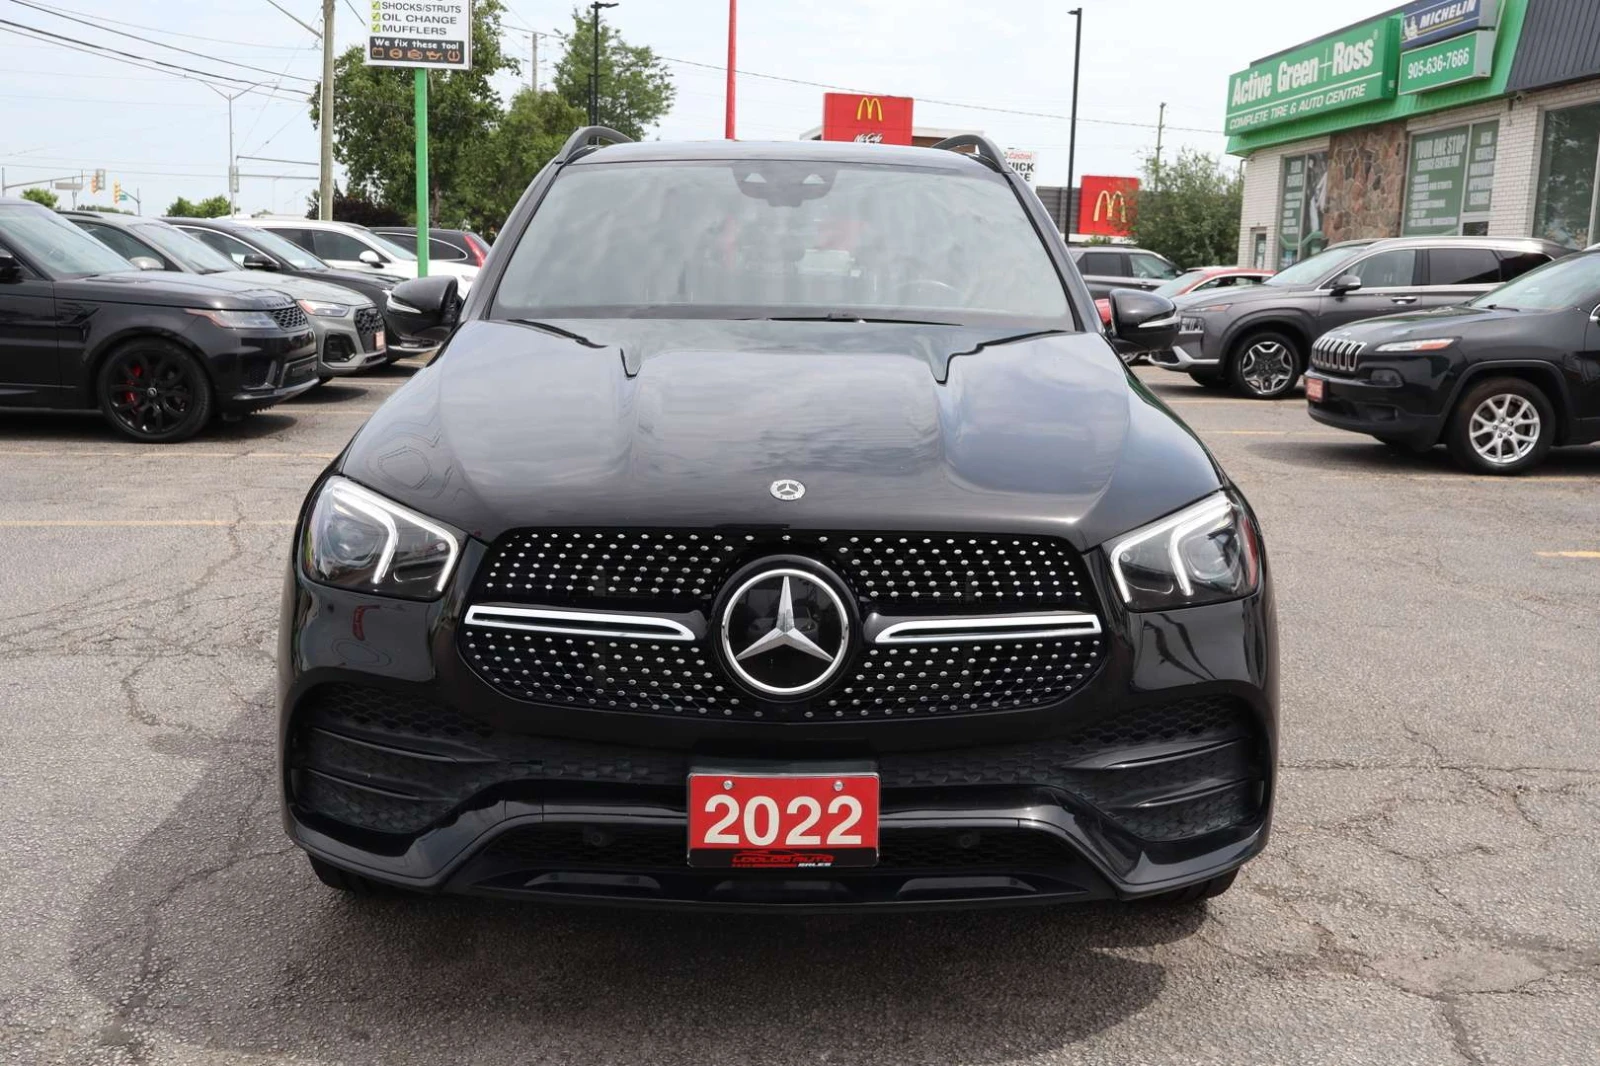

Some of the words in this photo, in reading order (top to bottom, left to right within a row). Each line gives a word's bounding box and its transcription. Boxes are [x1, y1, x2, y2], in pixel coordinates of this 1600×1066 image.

[382, 2, 462, 13] SHOCKS/STRUTS
[382, 13, 402, 22] OIL
[405, 14, 457, 25] CHANGE
[1419, 0, 1477, 29] MICHELIN
[374, 38, 390, 47] We
[394, 39, 408, 48] fix
[412, 40, 438, 49] these
[382, 24, 447, 35] MUFFLERS
[1408, 47, 1470, 79] 905-636-7666
[1231, 70, 1273, 107] Active
[1277, 56, 1319, 94] Green
[1229, 109, 1269, 130] COMPLETE
[1271, 104, 1289, 119] TIRE
[1290, 102, 1297, 114] &
[1298, 95, 1324, 112] AUTO
[1325, 83, 1368, 106] CENTRE
[704, 794, 863, 846] 2022
